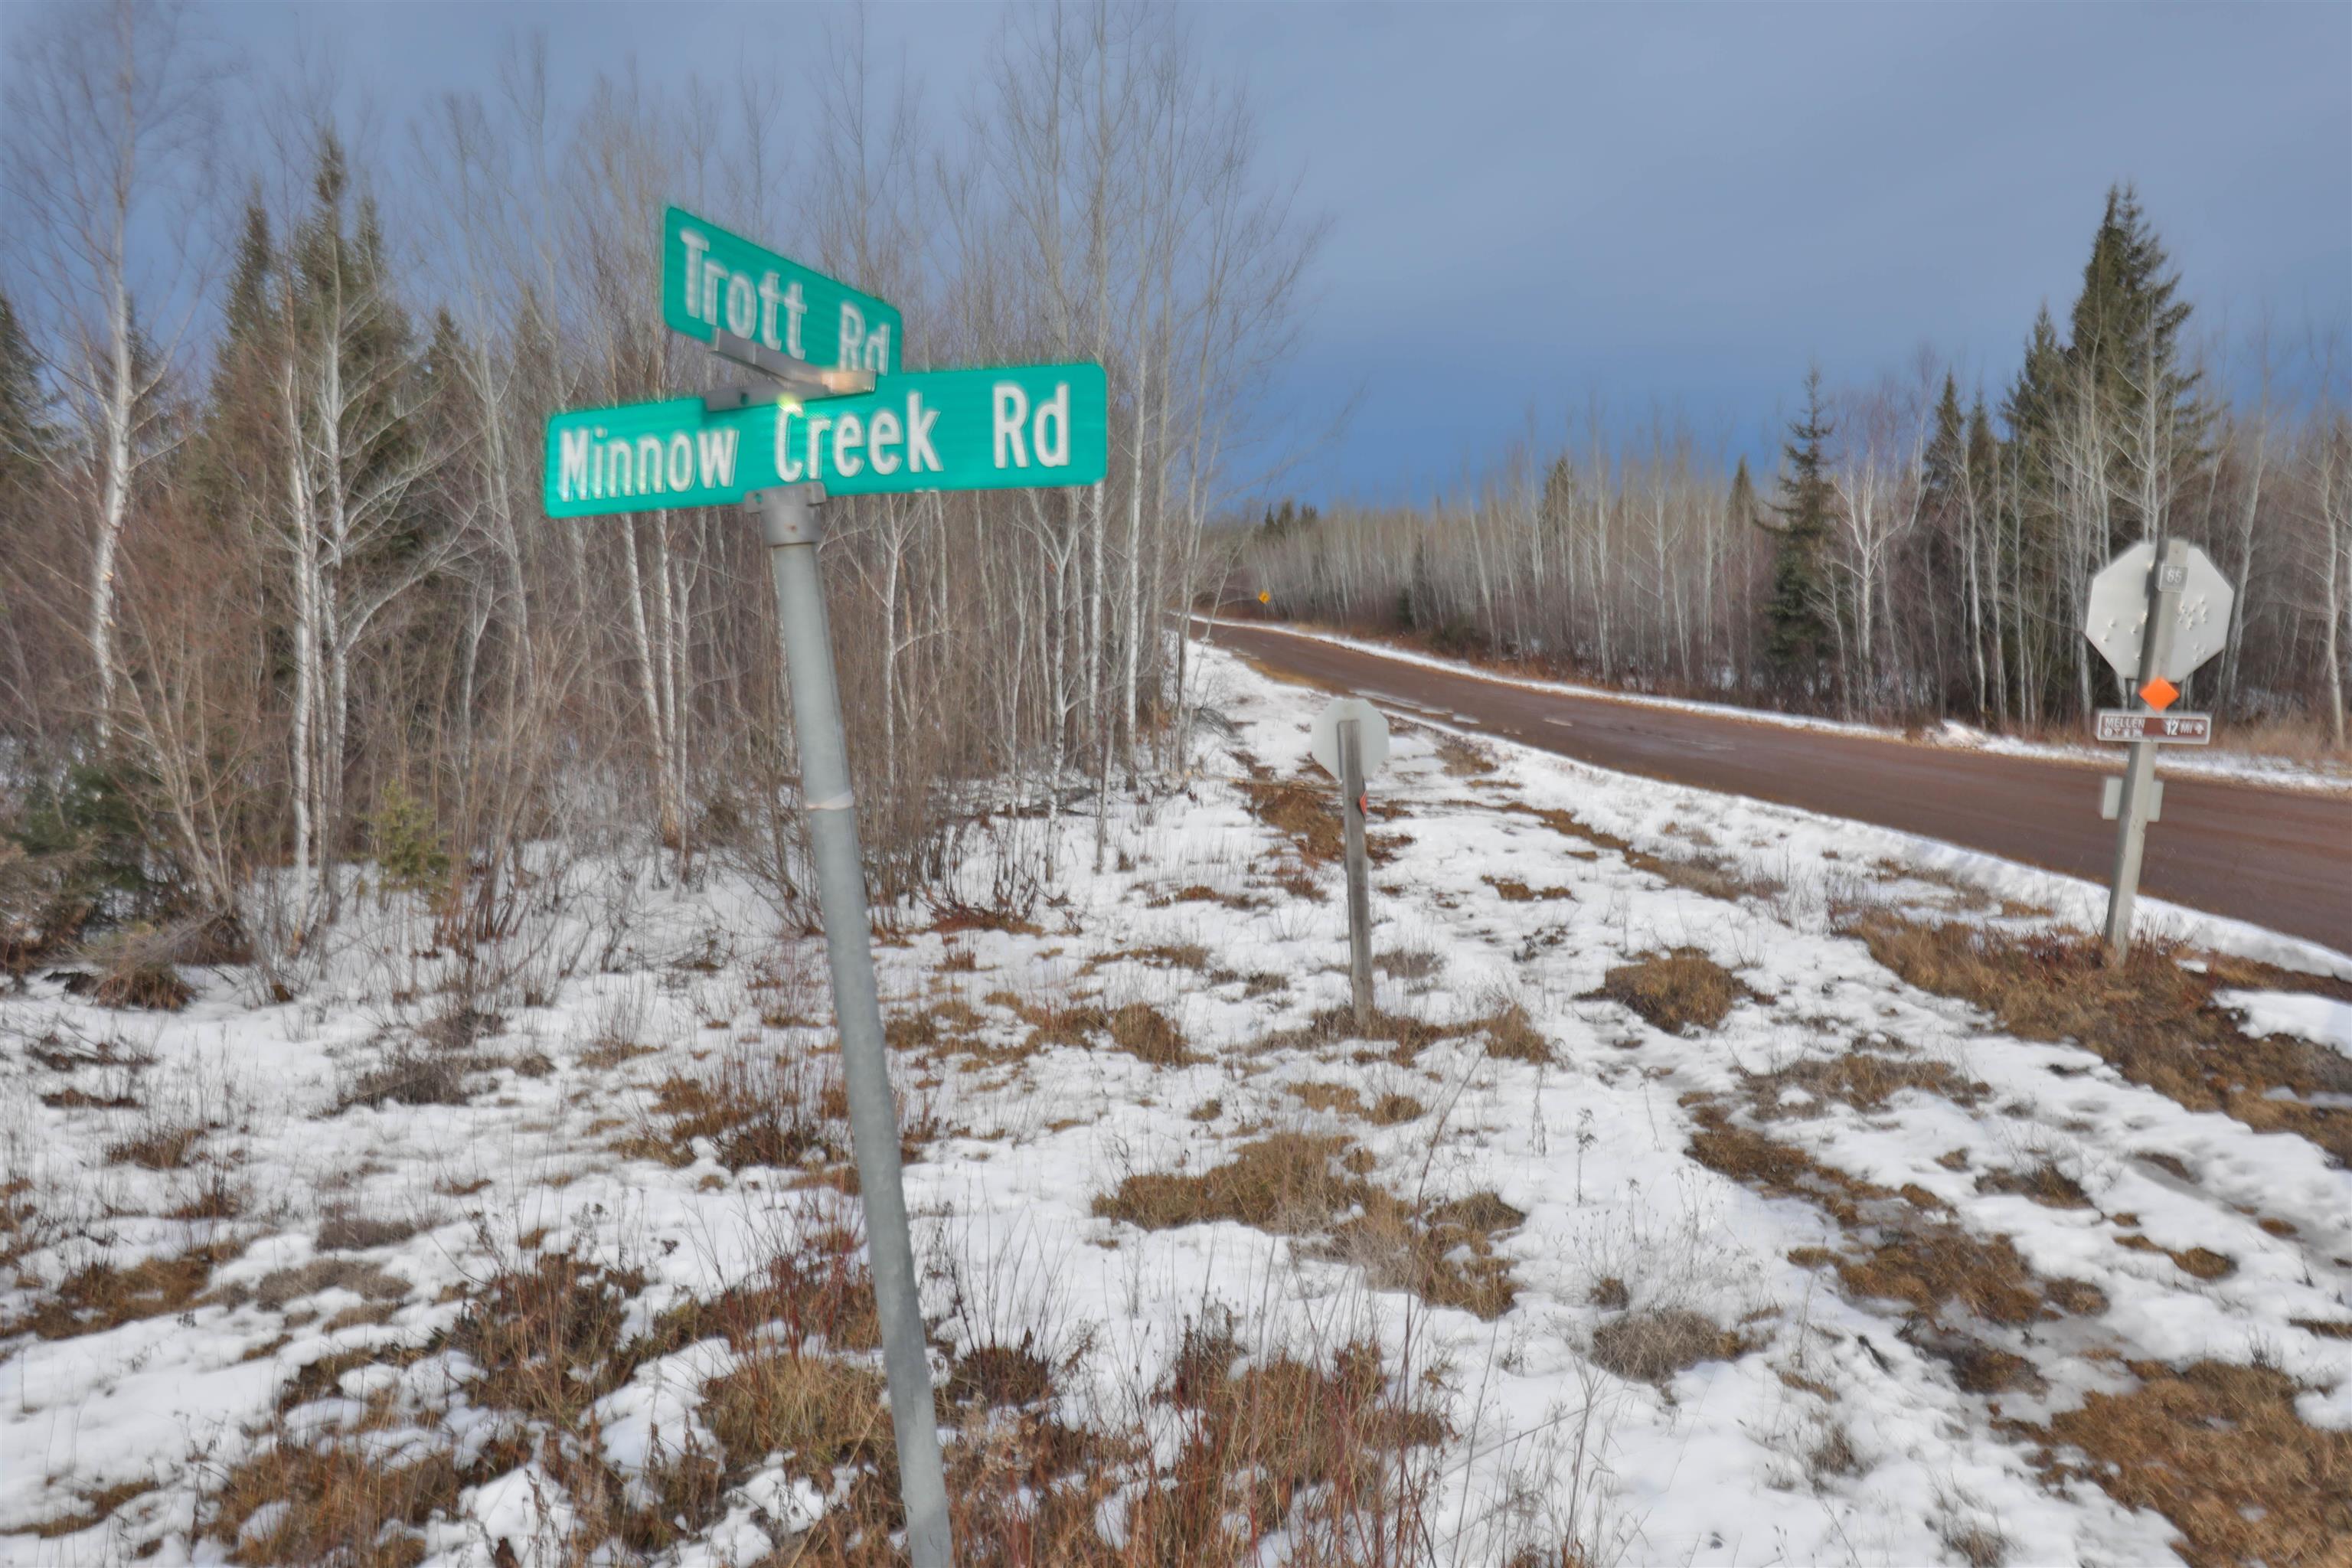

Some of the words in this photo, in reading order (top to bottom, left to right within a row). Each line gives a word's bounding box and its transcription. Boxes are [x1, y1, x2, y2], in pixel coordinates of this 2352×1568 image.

[680, 229, 807, 361] Trott
[840, 302, 890, 376] Rd
[560, 428, 740, 501] Minnow
[774, 391, 944, 482] Creek
[993, 383, 1070, 469] Rd
[2105, 717, 2145, 728] MELLEN
[2167, 718, 2180, 735] 12
